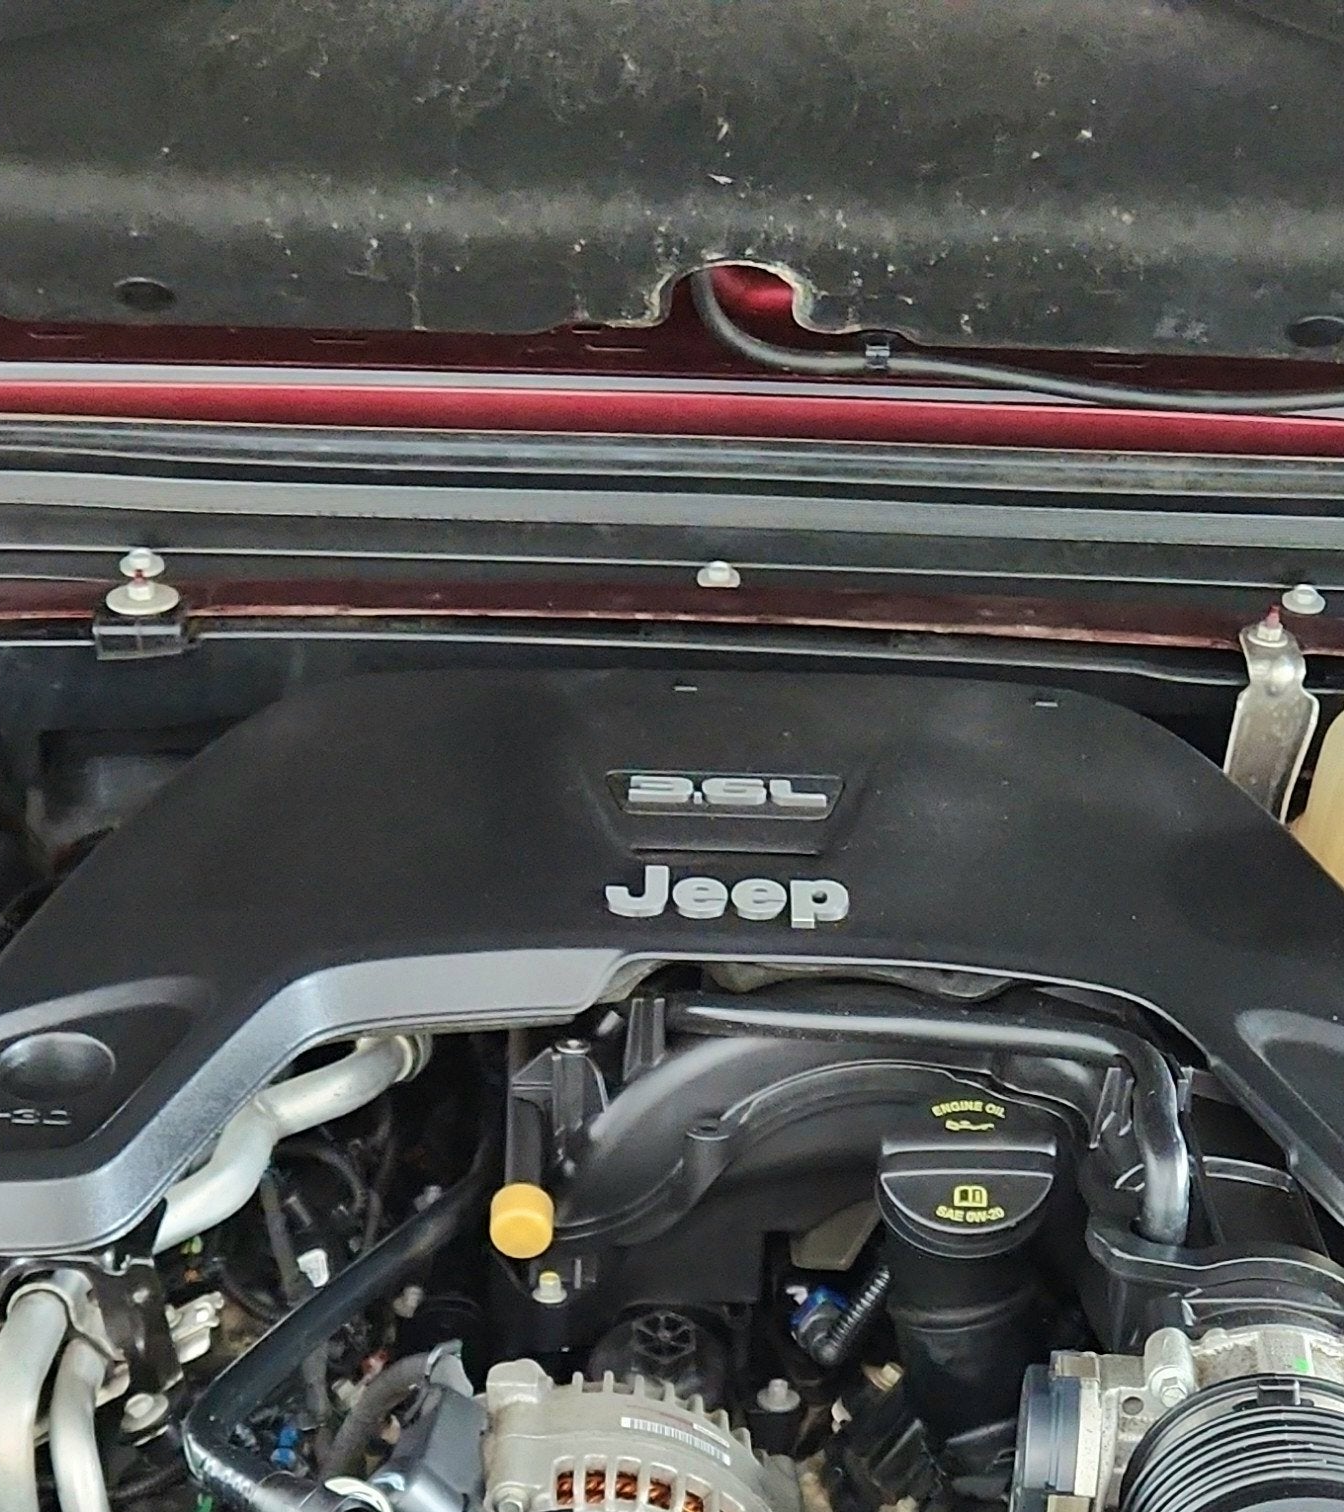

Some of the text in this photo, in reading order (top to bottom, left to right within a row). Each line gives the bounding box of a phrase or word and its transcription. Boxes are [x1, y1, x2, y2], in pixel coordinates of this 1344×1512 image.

[628, 775, 827, 807] 3.6L
[605, 865, 849, 929] Jeep
[931, 1101, 1006, 1118] ENGINE OIL
[935, 1205, 1005, 1222] SAE 0W-20
